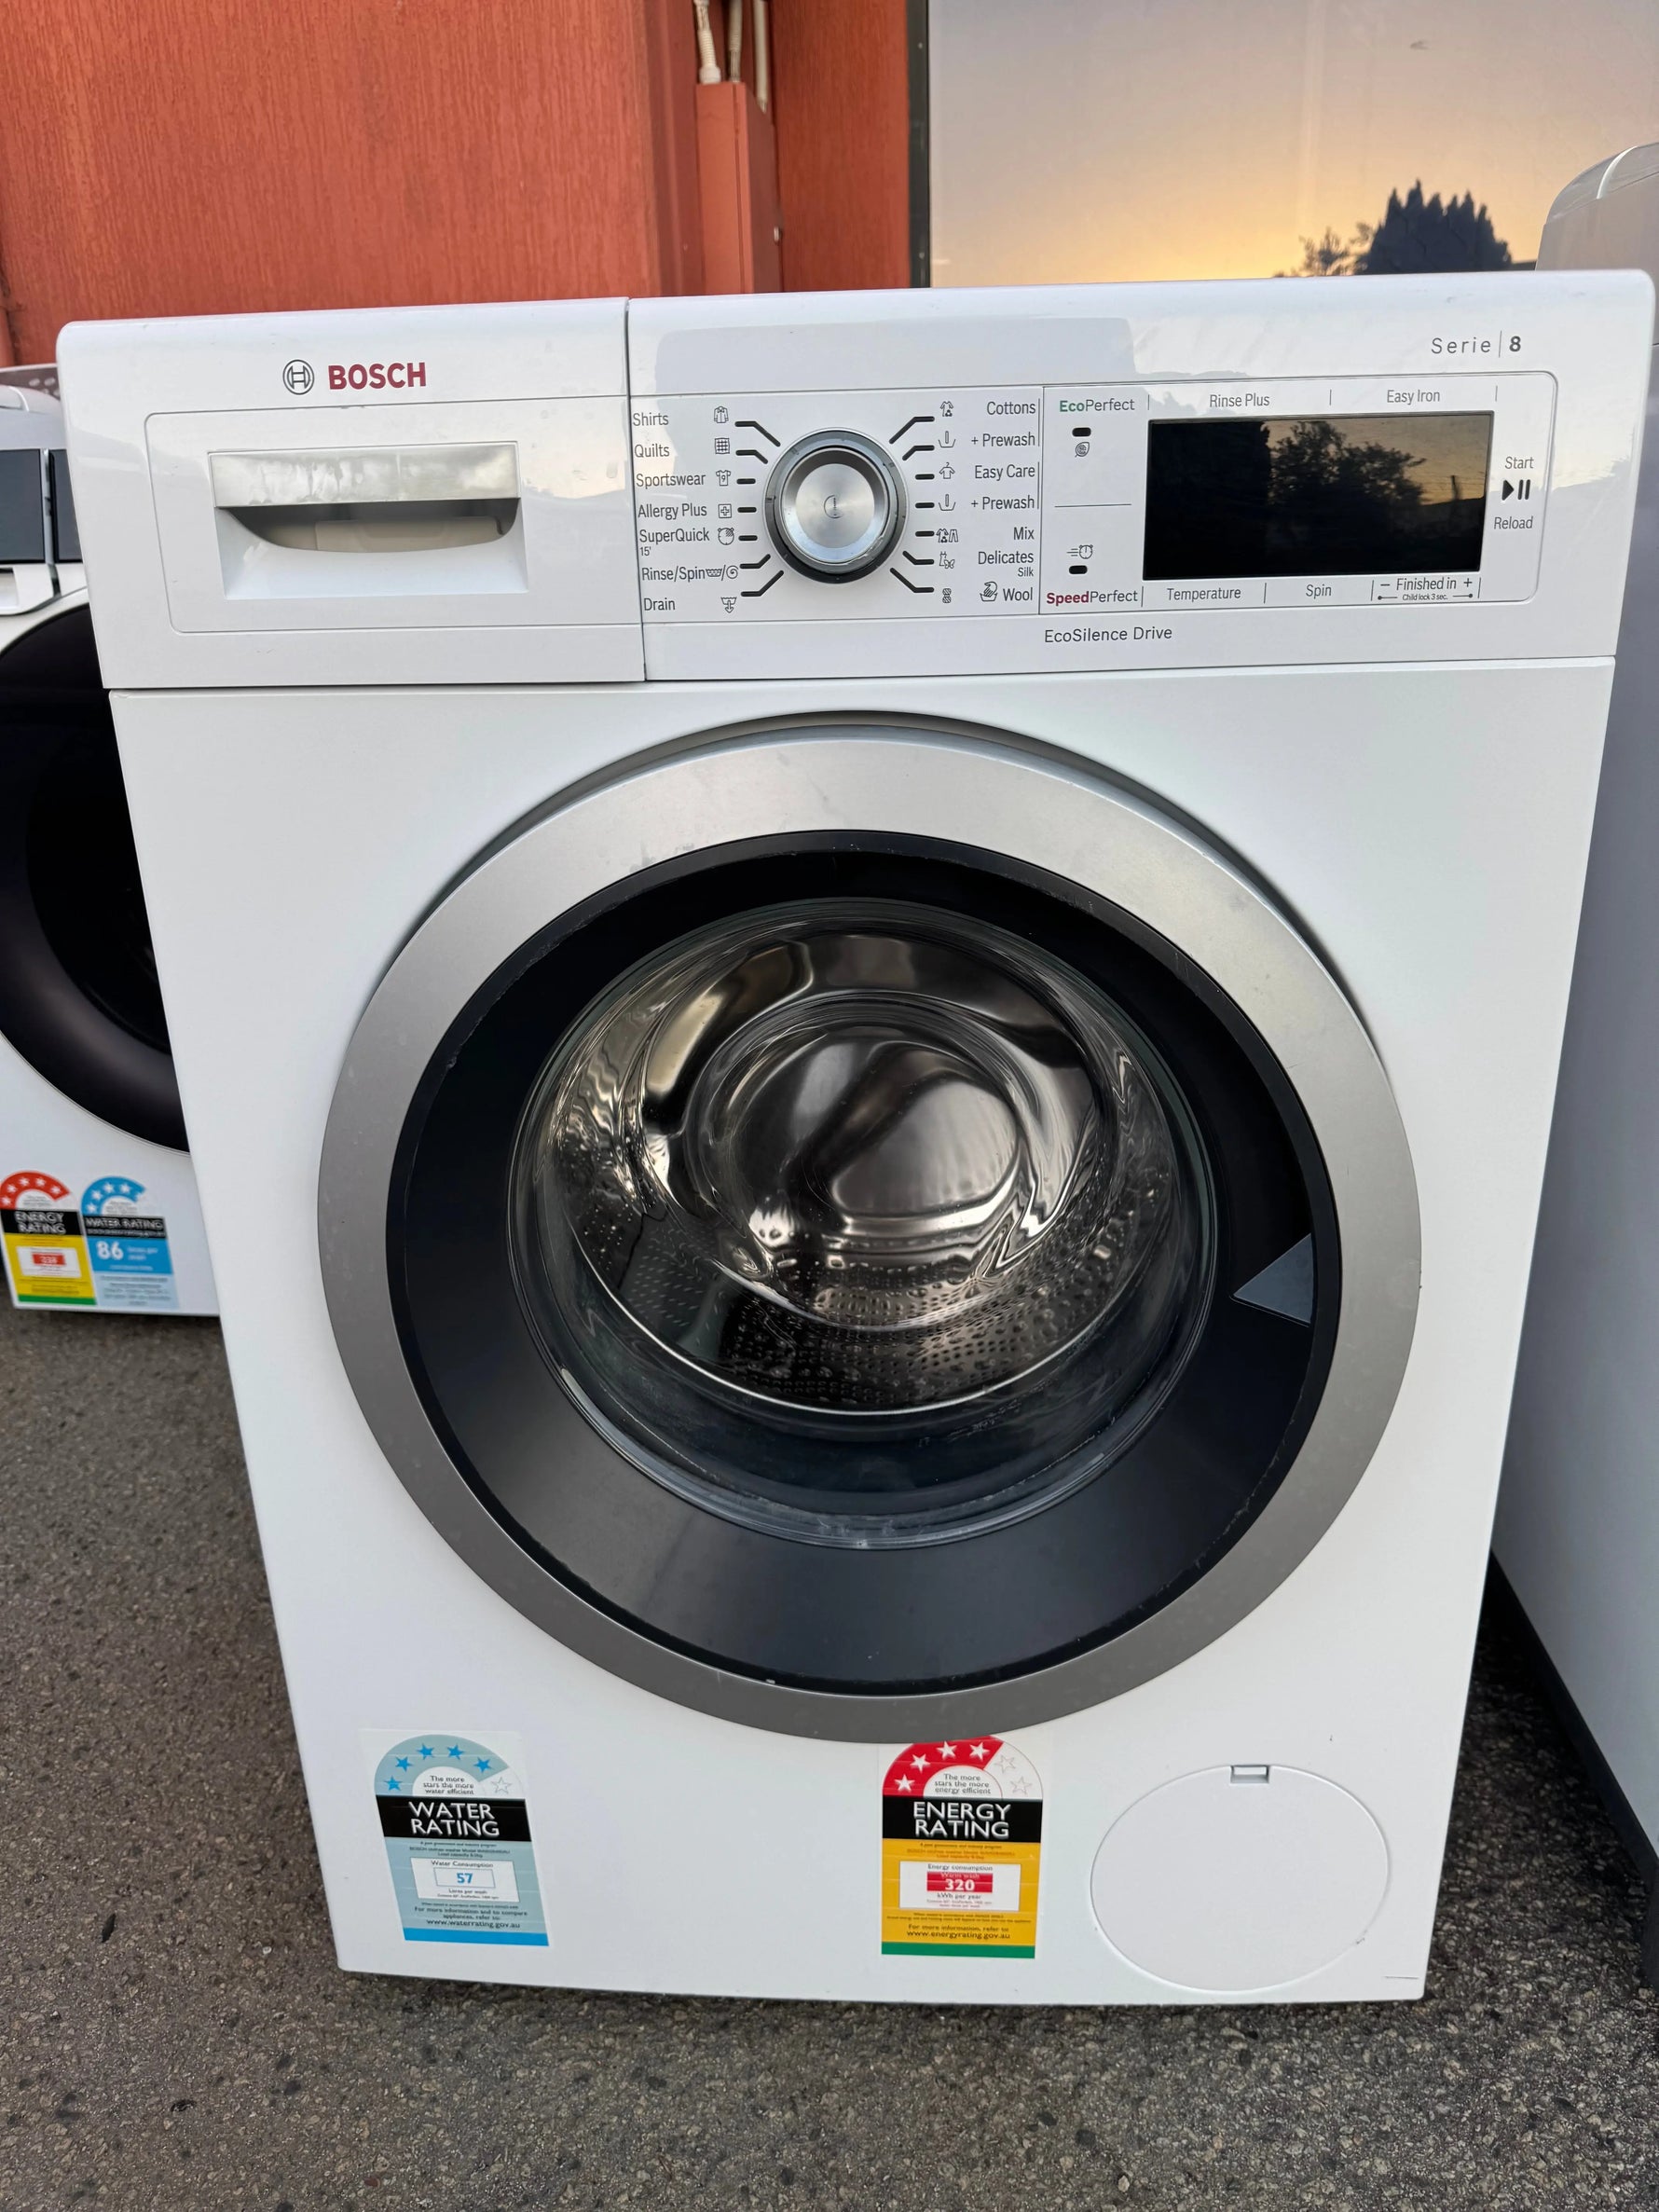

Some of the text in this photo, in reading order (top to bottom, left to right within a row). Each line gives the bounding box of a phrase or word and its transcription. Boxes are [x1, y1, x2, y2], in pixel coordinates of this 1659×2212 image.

[1431, 336, 1521, 354] Serie 8
[328, 362, 427, 390] BOSCH
[1209, 392, 1270, 407] Rinse Plus
[1387, 389, 1440, 405] Easy Iron
[986, 401, 1035, 415] Cottons
[1059, 398, 1135, 412] EcoPerfect
[633, 412, 669, 426] Shirts
[982, 432, 1035, 447] Prewash
[634, 443, 670, 458] Quilts
[1504, 457, 1534, 469] Start
[975, 463, 1035, 481] Easy Care
[636, 473, 706, 489] Sportswear
[982, 495, 1035, 510] Prewash
[638, 502, 707, 520] Allergy Plus
[1494, 515, 1533, 529] Reload
[639, 528, 710, 545] SuperQuick
[1013, 527, 1035, 541] Mix
[978, 550, 1035, 565] Delicates
[641, 564, 706, 583] Rinse/Spin
[1017, 567, 1035, 577] Silk
[1396, 576, 1445, 591] Finished
[1446, 577, 1457, 589] in
[1003, 587, 1033, 601] Wool
[1046, 590, 1138, 607] SpeedPerfect
[1167, 587, 1241, 602] Temperature
[1306, 584, 1332, 599] Spin
[643, 598, 676, 611] Drain
[1045, 626, 1172, 643] EcoSilence Drive
[15, 1211, 63, 1223] ENERGY
[18, 1222, 66, 1235] RATING
[96, 1241, 124, 1260] 86
[408, 1801, 495, 1820] WATER
[913, 1801, 1011, 1820] ENERGY
[411, 1819, 500, 1836] RATING
[915, 1819, 1009, 1839] RATING
[457, 1872, 473, 1884] 57
[945, 1878, 976, 1891] 320
[426, 1919, 521, 1929] www.waterrating.gov.au
[907, 1930, 1010, 1940] www.energyrating.gov.au
